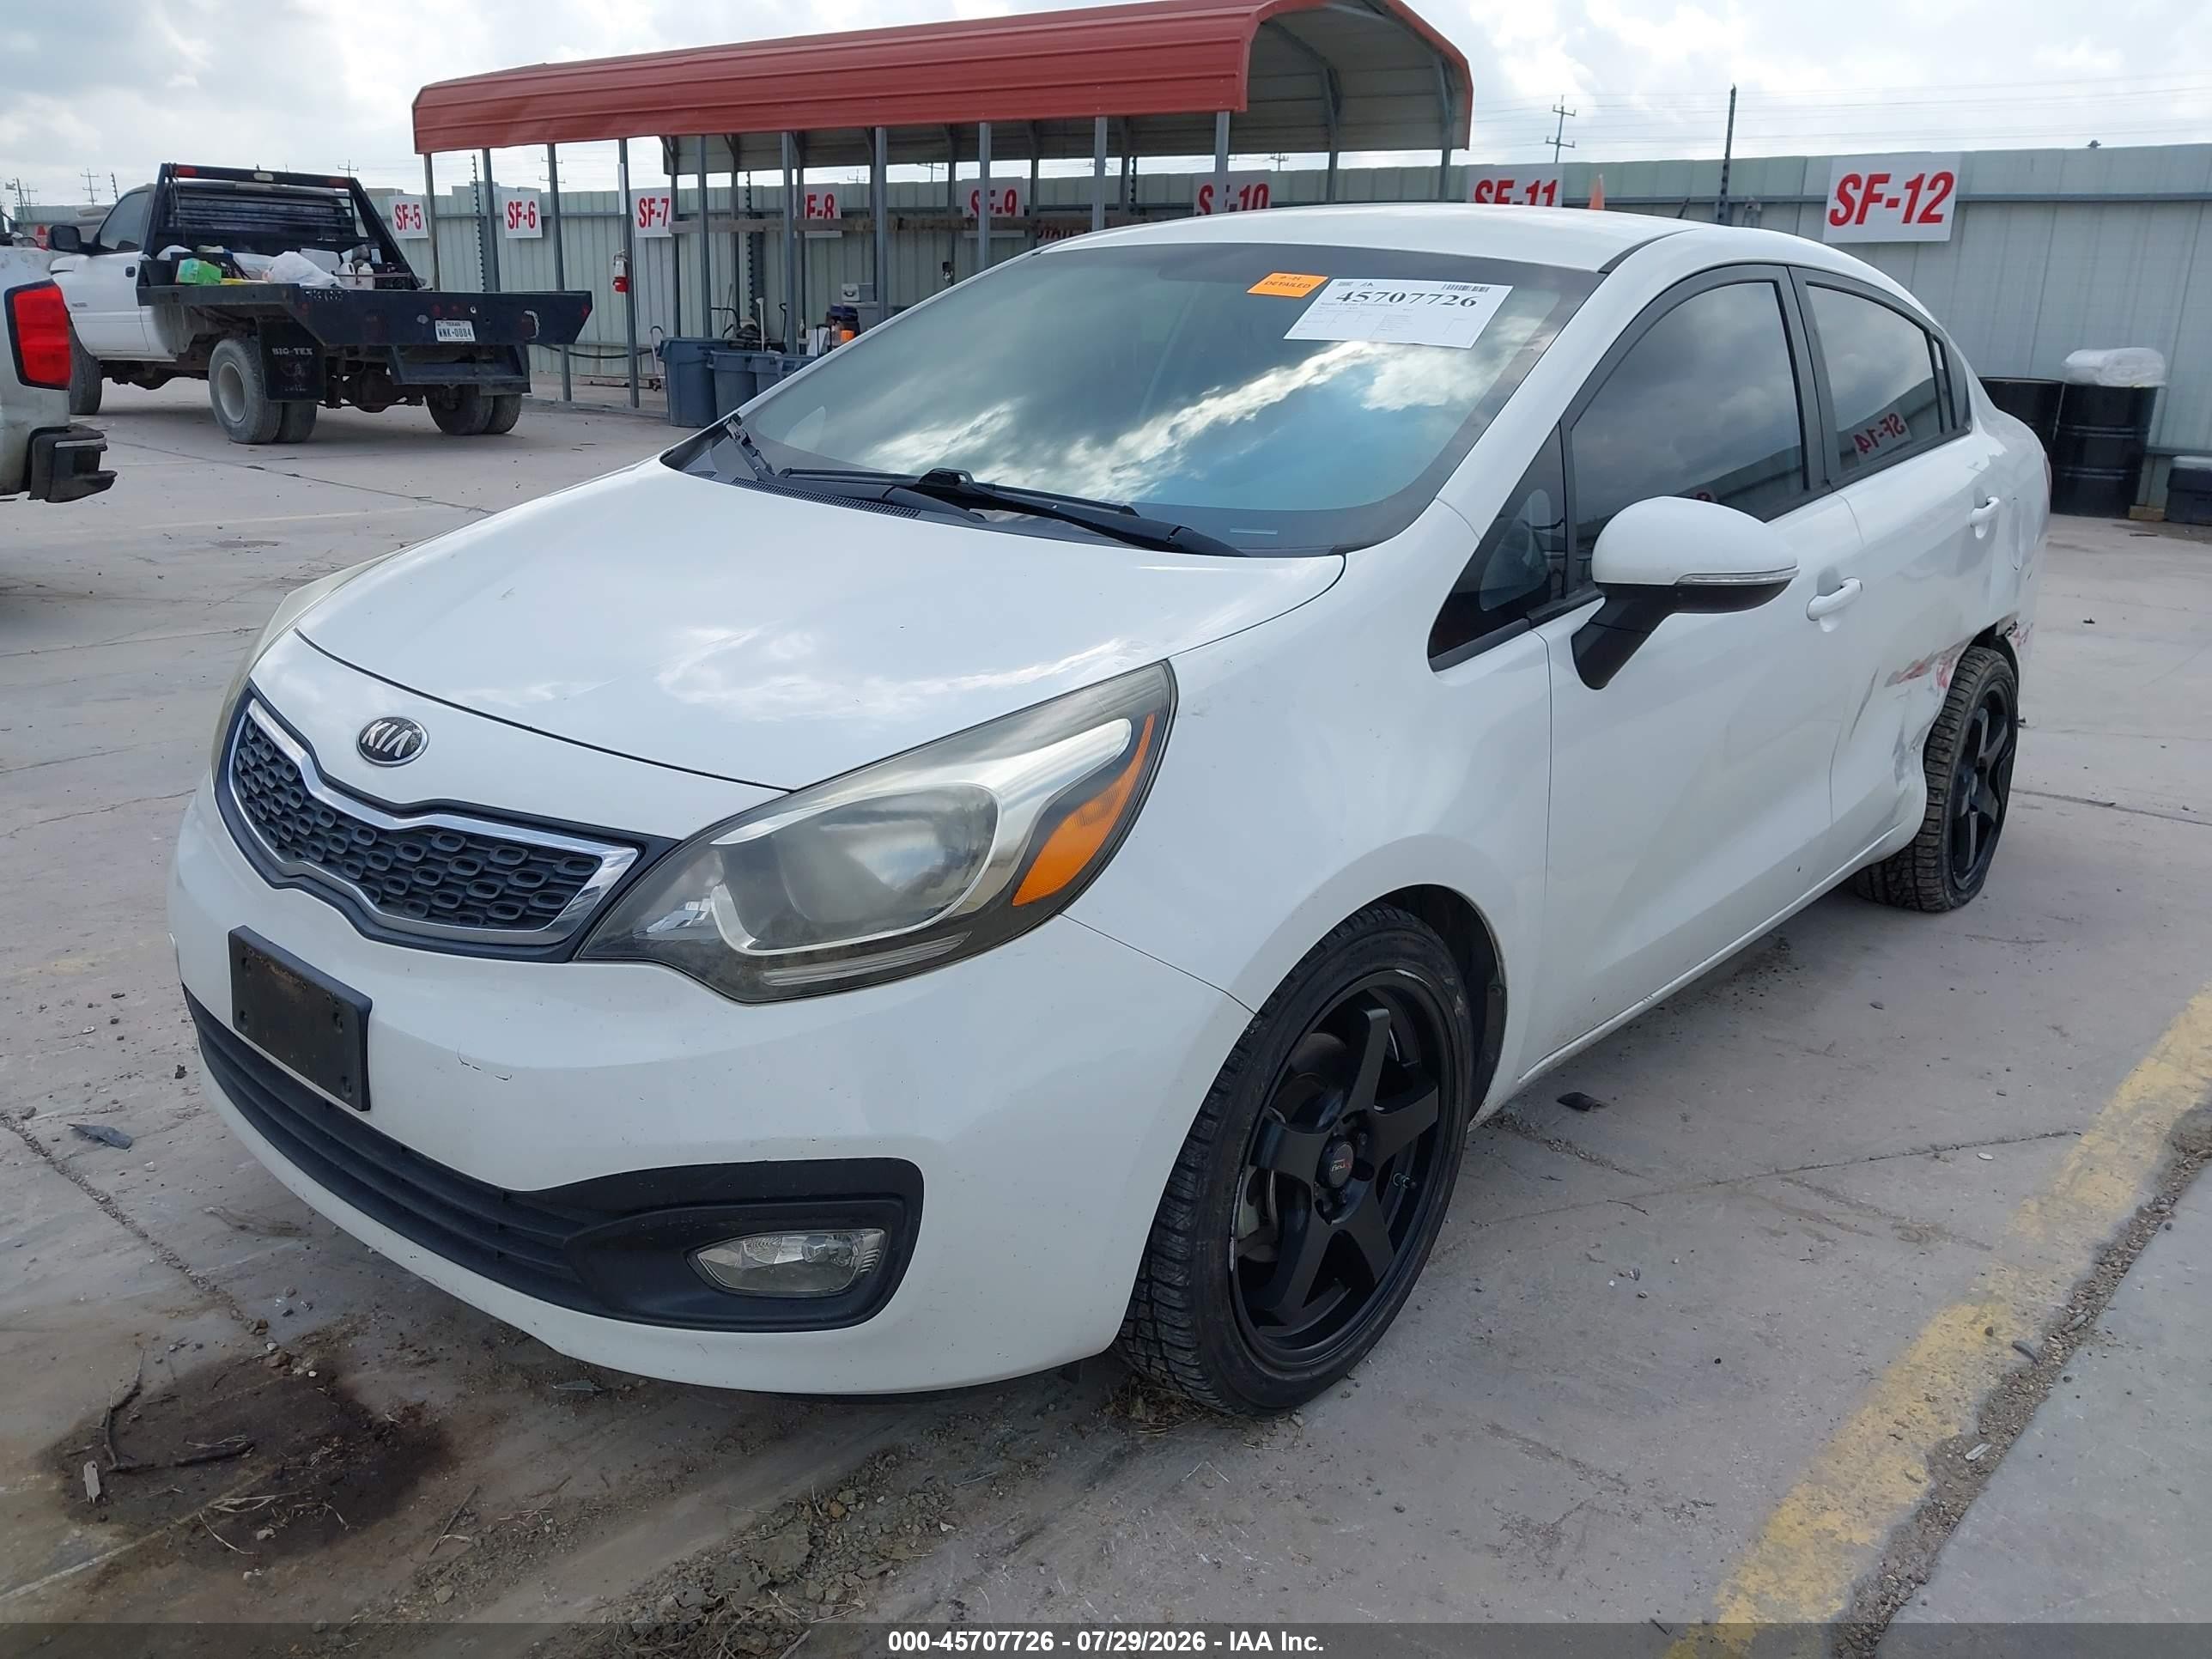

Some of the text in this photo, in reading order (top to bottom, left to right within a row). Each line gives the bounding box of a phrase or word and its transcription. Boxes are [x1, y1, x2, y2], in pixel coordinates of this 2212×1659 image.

[638, 197, 670, 228] SF-7
[1829, 171, 1955, 228] SF-12
[394, 204, 422, 231] SF-5
[507, 200, 536, 229] SF-6
[1335, 289, 1478, 308] 45707726
